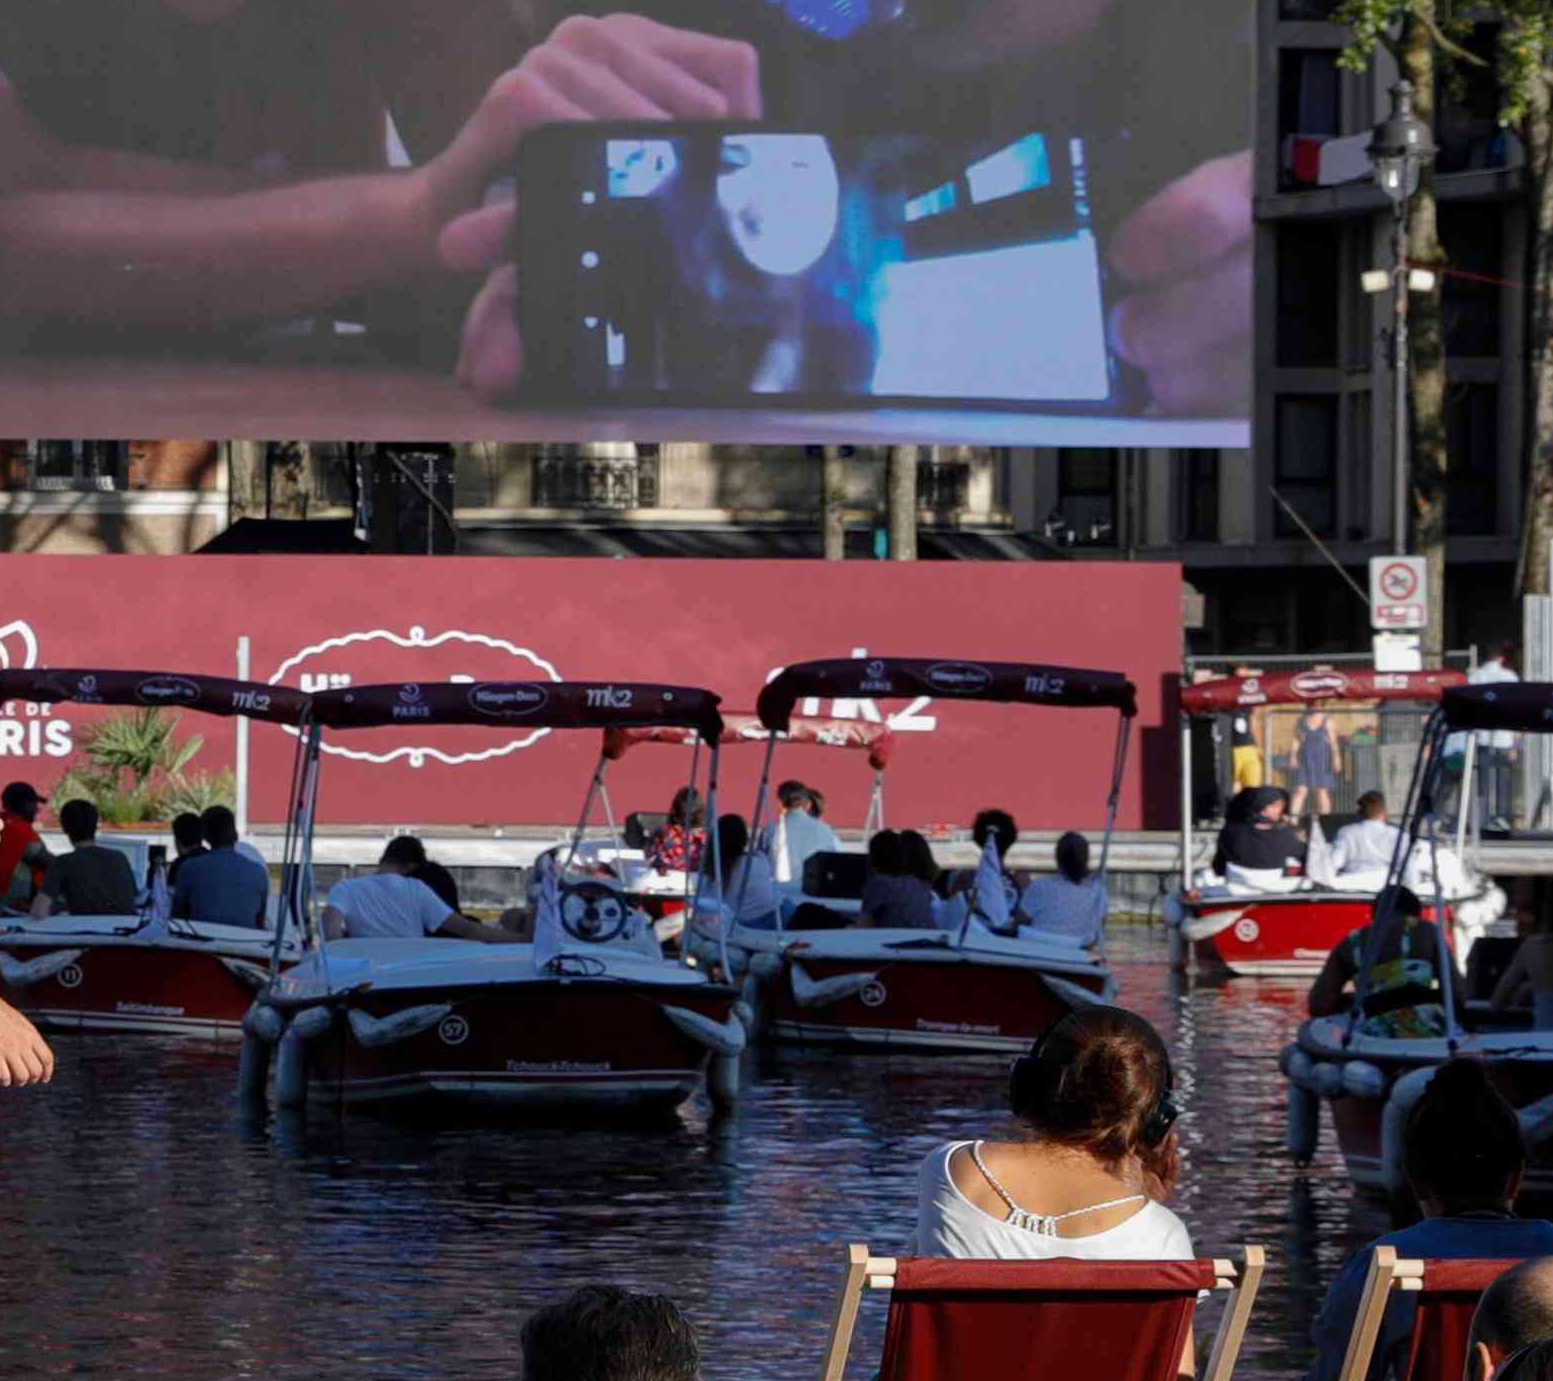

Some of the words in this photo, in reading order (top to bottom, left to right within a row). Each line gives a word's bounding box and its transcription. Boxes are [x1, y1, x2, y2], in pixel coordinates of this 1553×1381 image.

[1024, 673, 1065, 694] mk2
[232, 689, 271, 711] mk2
[586, 688, 633, 708] mk2
[26, 702, 51, 716] DE
